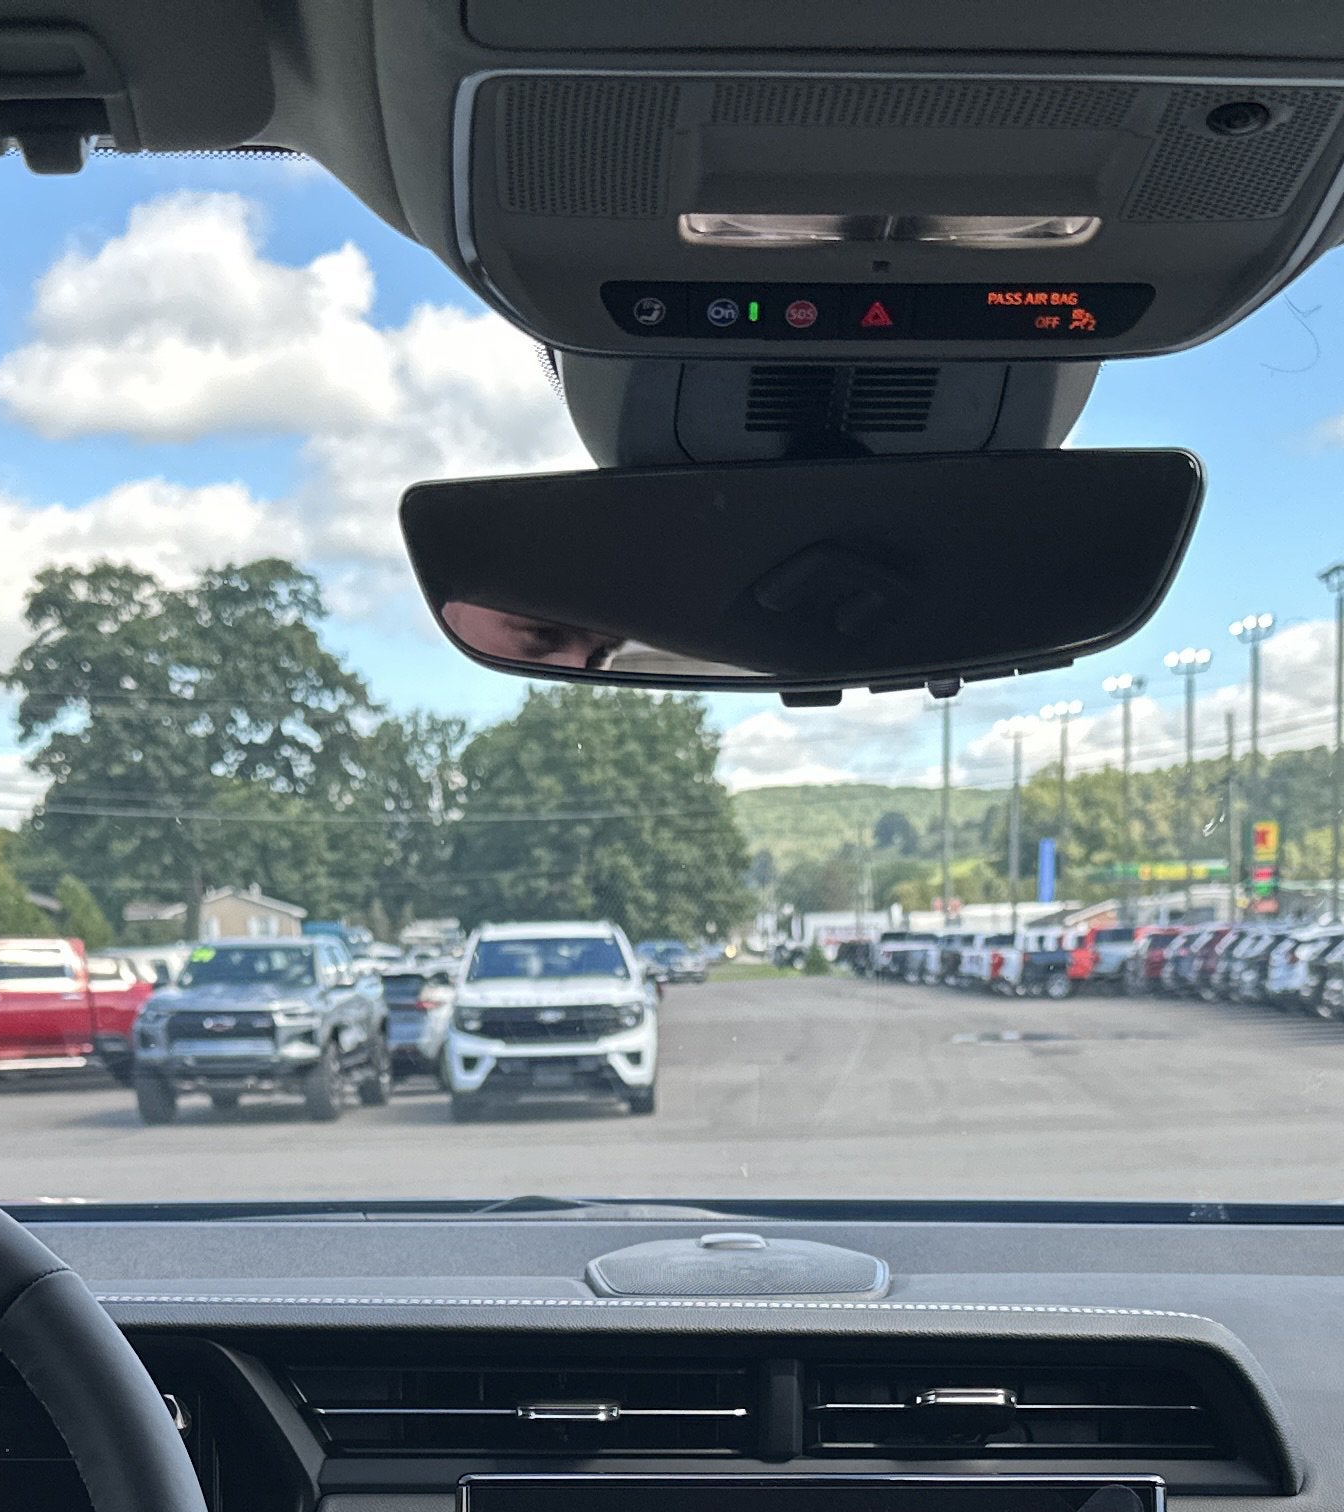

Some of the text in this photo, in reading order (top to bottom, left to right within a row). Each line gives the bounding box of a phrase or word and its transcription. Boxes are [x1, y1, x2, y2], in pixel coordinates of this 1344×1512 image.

[987, 291, 1079, 306] PASS AIR BAG
[789, 308, 815, 321] SOS
[1035, 316, 1061, 329] OFF
